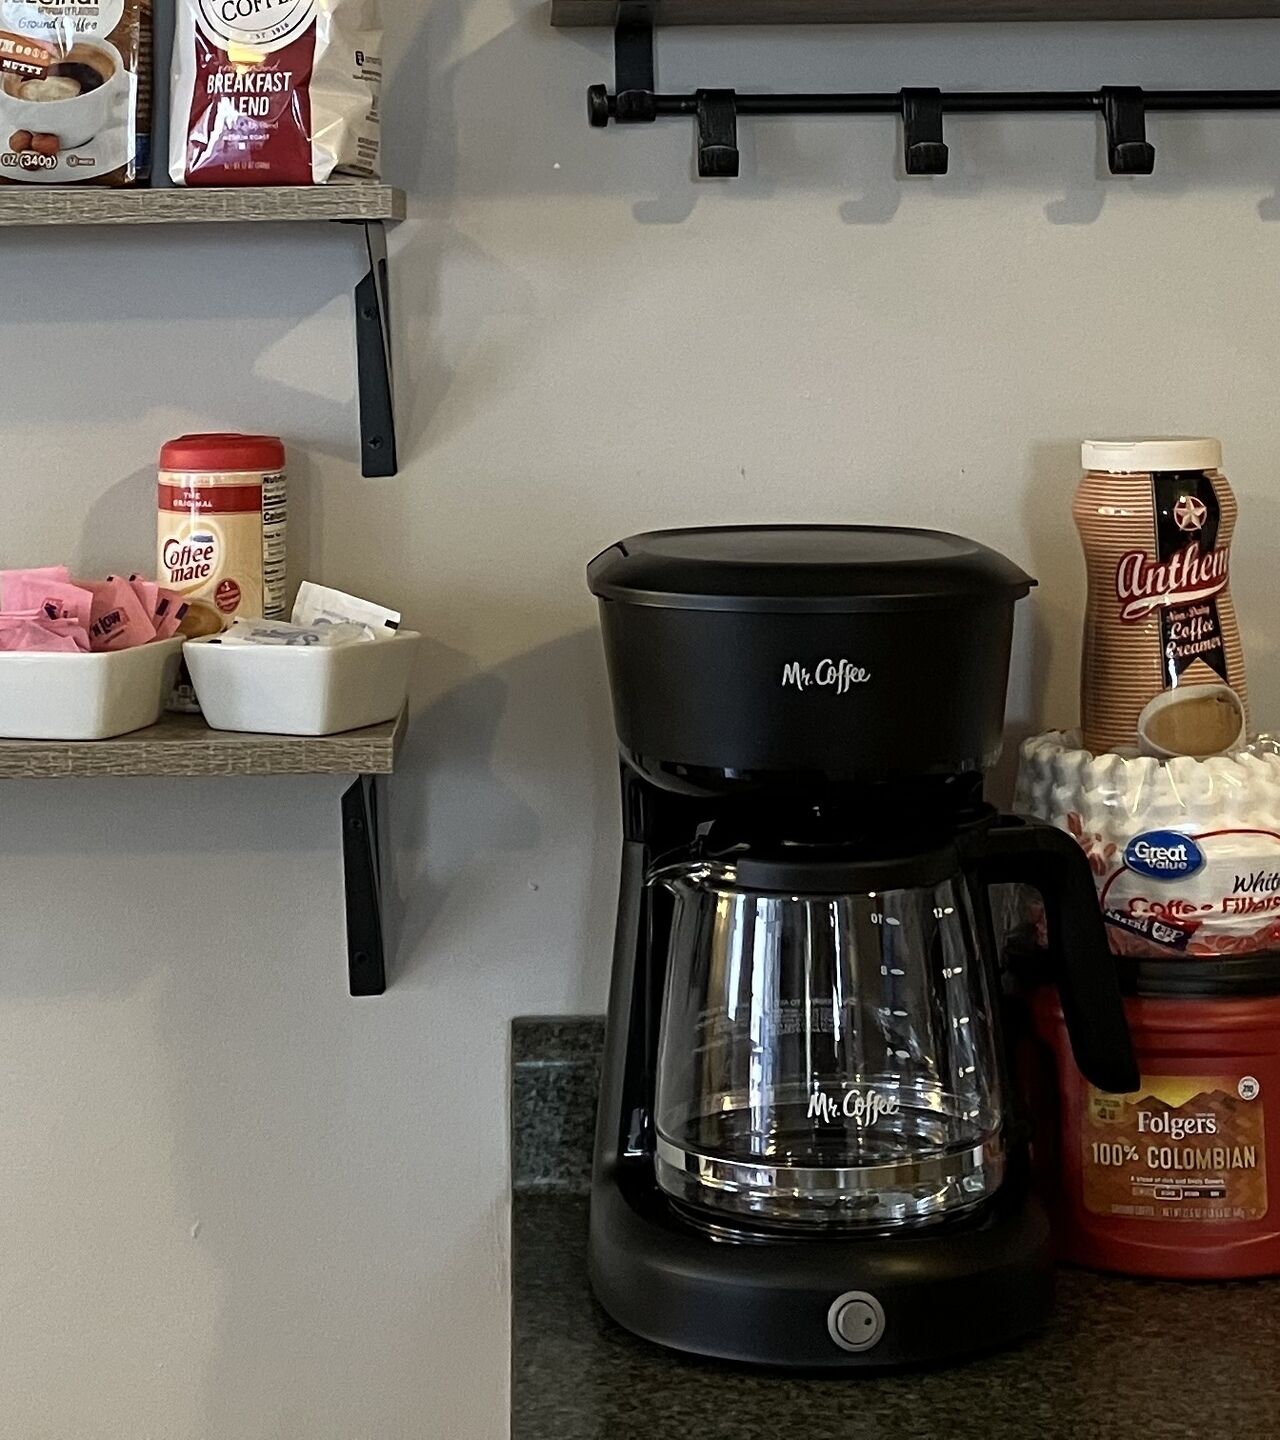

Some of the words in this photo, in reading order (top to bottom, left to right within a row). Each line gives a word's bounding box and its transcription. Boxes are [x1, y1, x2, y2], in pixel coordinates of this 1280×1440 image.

[18, 16, 58, 30] Ground
[2, 59, 43, 76] NUTTY
[206, 71, 293, 95] BREAKFAST
[1, 152, 17, 166] OZ
[19, 152, 59, 169] (340g)
[172, 499, 213, 508] ORIGINAL
[163, 538, 214, 570] Coffee
[170, 563, 211, 583] mate
[1117, 541, 1230, 600] Anthem
[1169, 616, 1215, 642] Coffee
[1165, 636, 1222, 659] Creamer
[782, 661, 814, 687] Mr.
[814, 658, 871, 695] Coffee
[1134, 840, 1189, 861] Great
[1147, 858, 1189, 871] Value
[806, 1091, 841, 1124] Mr.
[842, 1088, 901, 1127] Coffee
[1137, 1111, 1218, 1141] Folgers
[1091, 1141, 1140, 1166] 100%
[1146, 1145, 1256, 1171] COLOMBIAN
